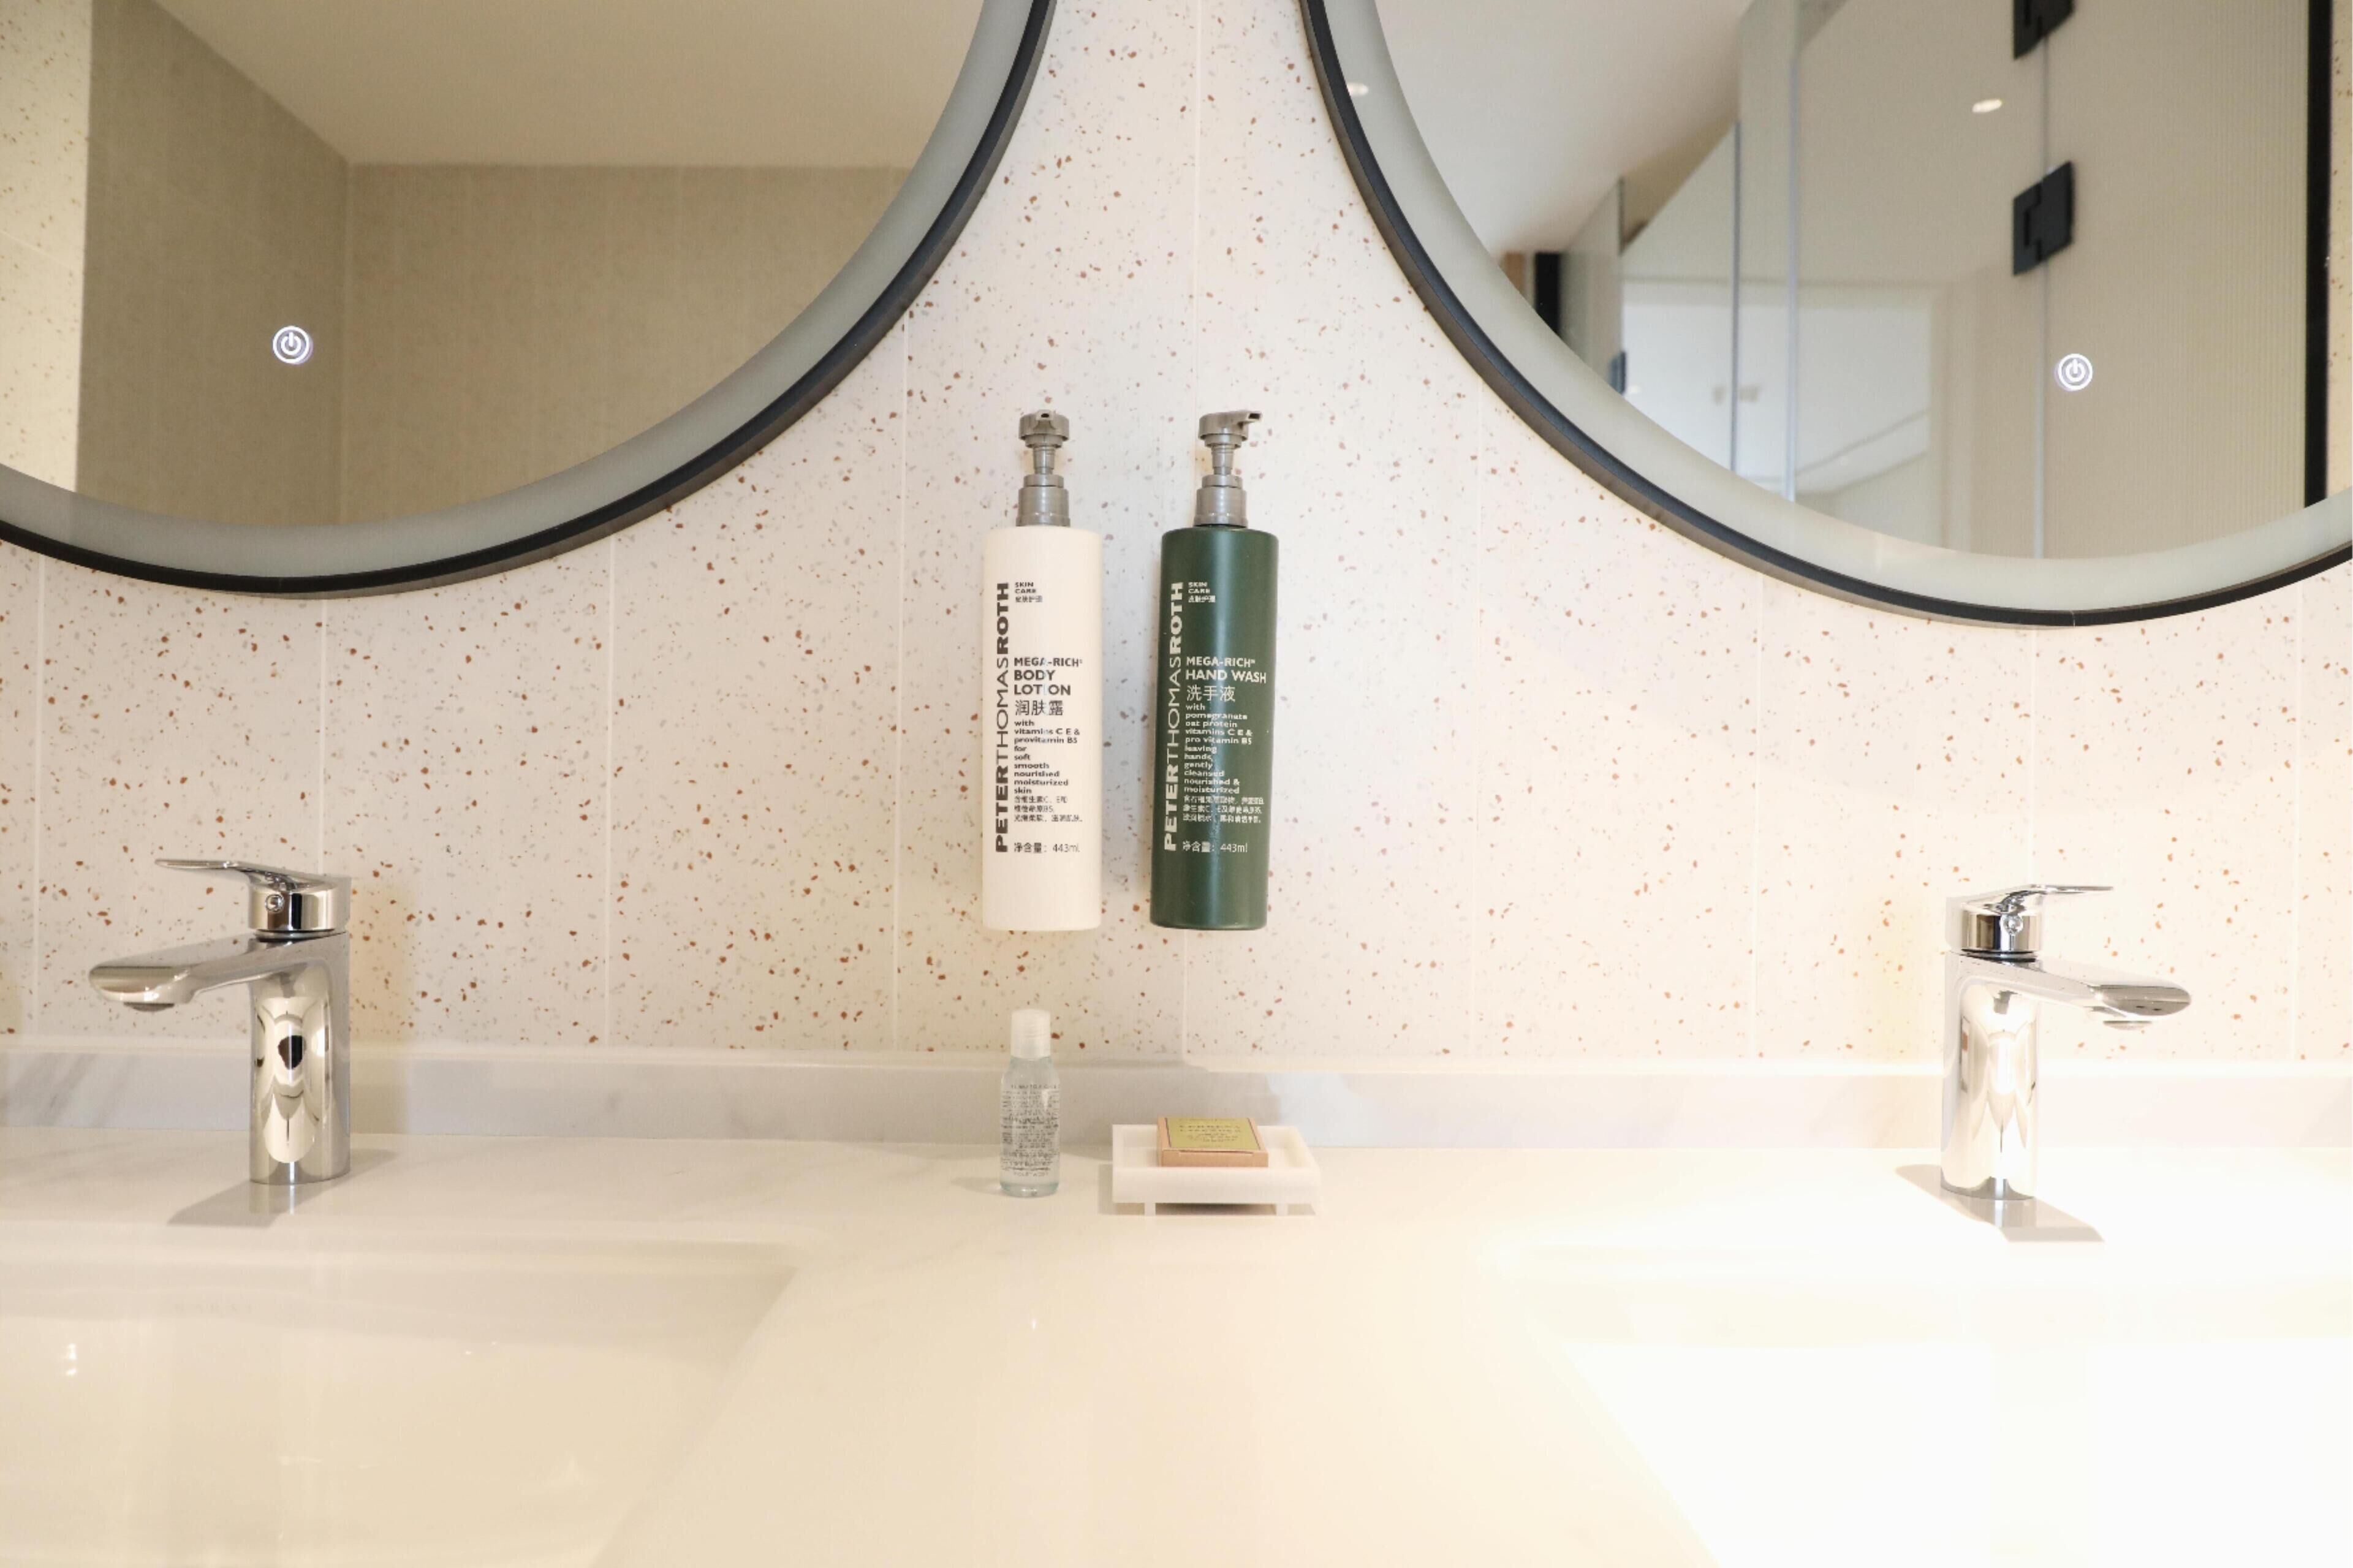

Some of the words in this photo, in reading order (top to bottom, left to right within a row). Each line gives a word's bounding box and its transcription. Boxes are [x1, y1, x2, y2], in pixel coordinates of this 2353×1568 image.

[1014, 670, 1056, 681] BODY
[1186, 670, 1227, 680] HAND
[1231, 670, 1267, 684] WASH
[1014, 684, 1071, 695] LOTION
[1187, 684, 1236, 702] 洗手液
[1015, 700, 1064, 716] 润肤露
[1014, 737, 1064, 745] provitamin
[1184, 745, 1217, 754] leaving
[1184, 762, 1213, 770] gently
[1184, 786, 1240, 794] moisturized
